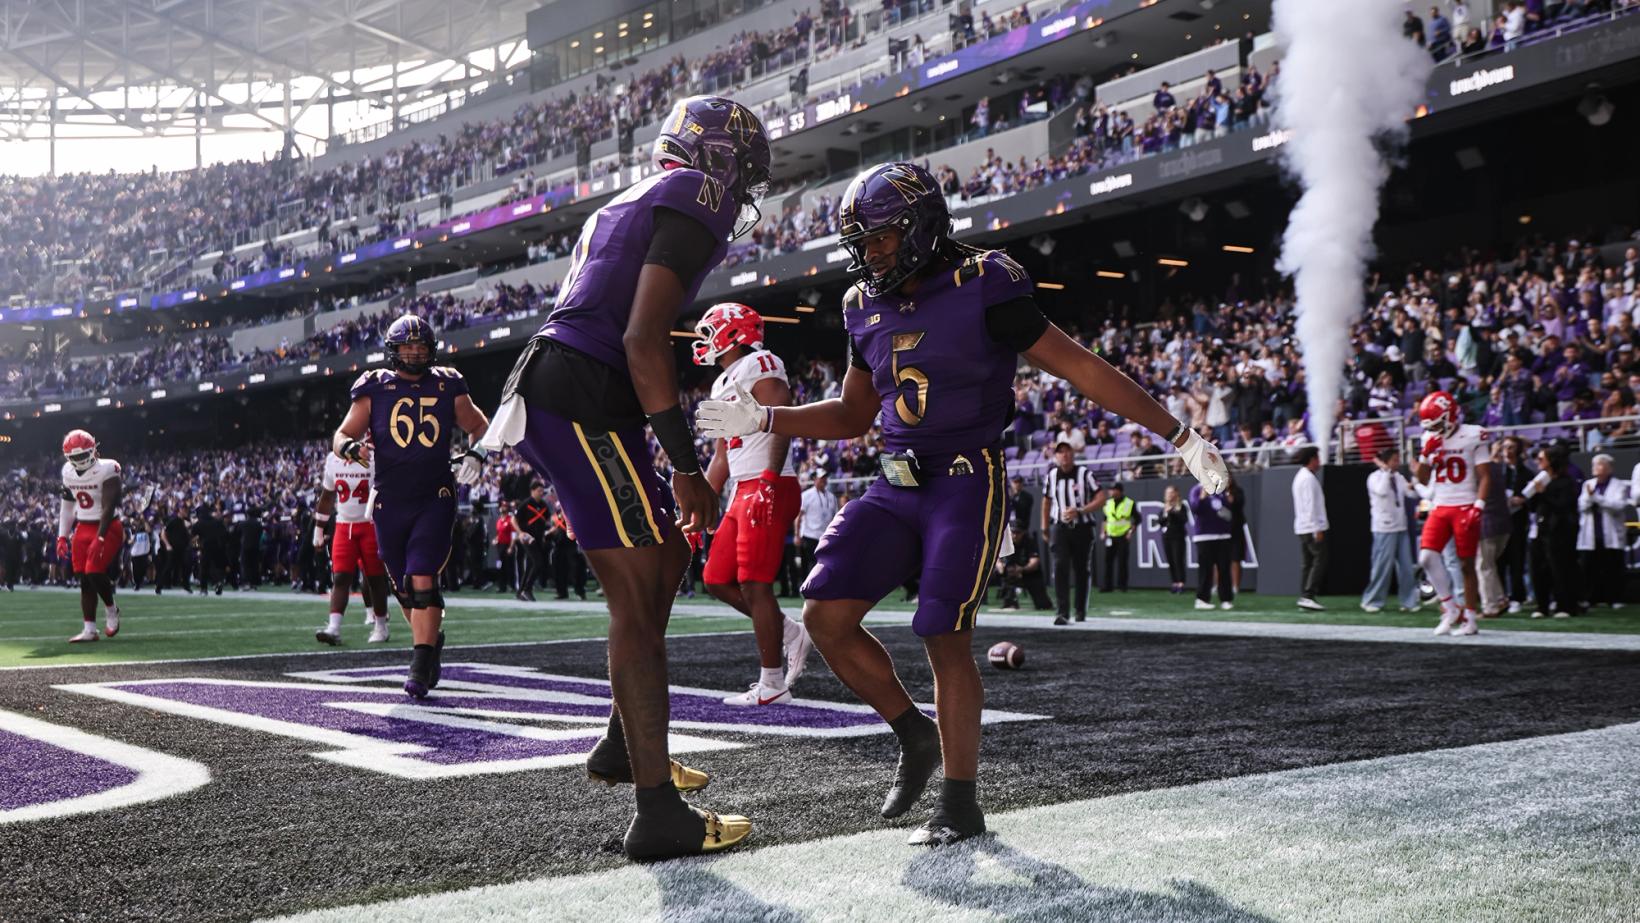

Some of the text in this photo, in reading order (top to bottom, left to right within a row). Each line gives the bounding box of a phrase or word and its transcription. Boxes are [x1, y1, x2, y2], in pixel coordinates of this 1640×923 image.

[696, 173, 726, 213] N
[757, 354, 778, 373] 11
[892, 331, 929, 425] 5
[390, 397, 440, 448] 65
[1433, 456, 1467, 484] 20
[334, 479, 371, 504] 94
